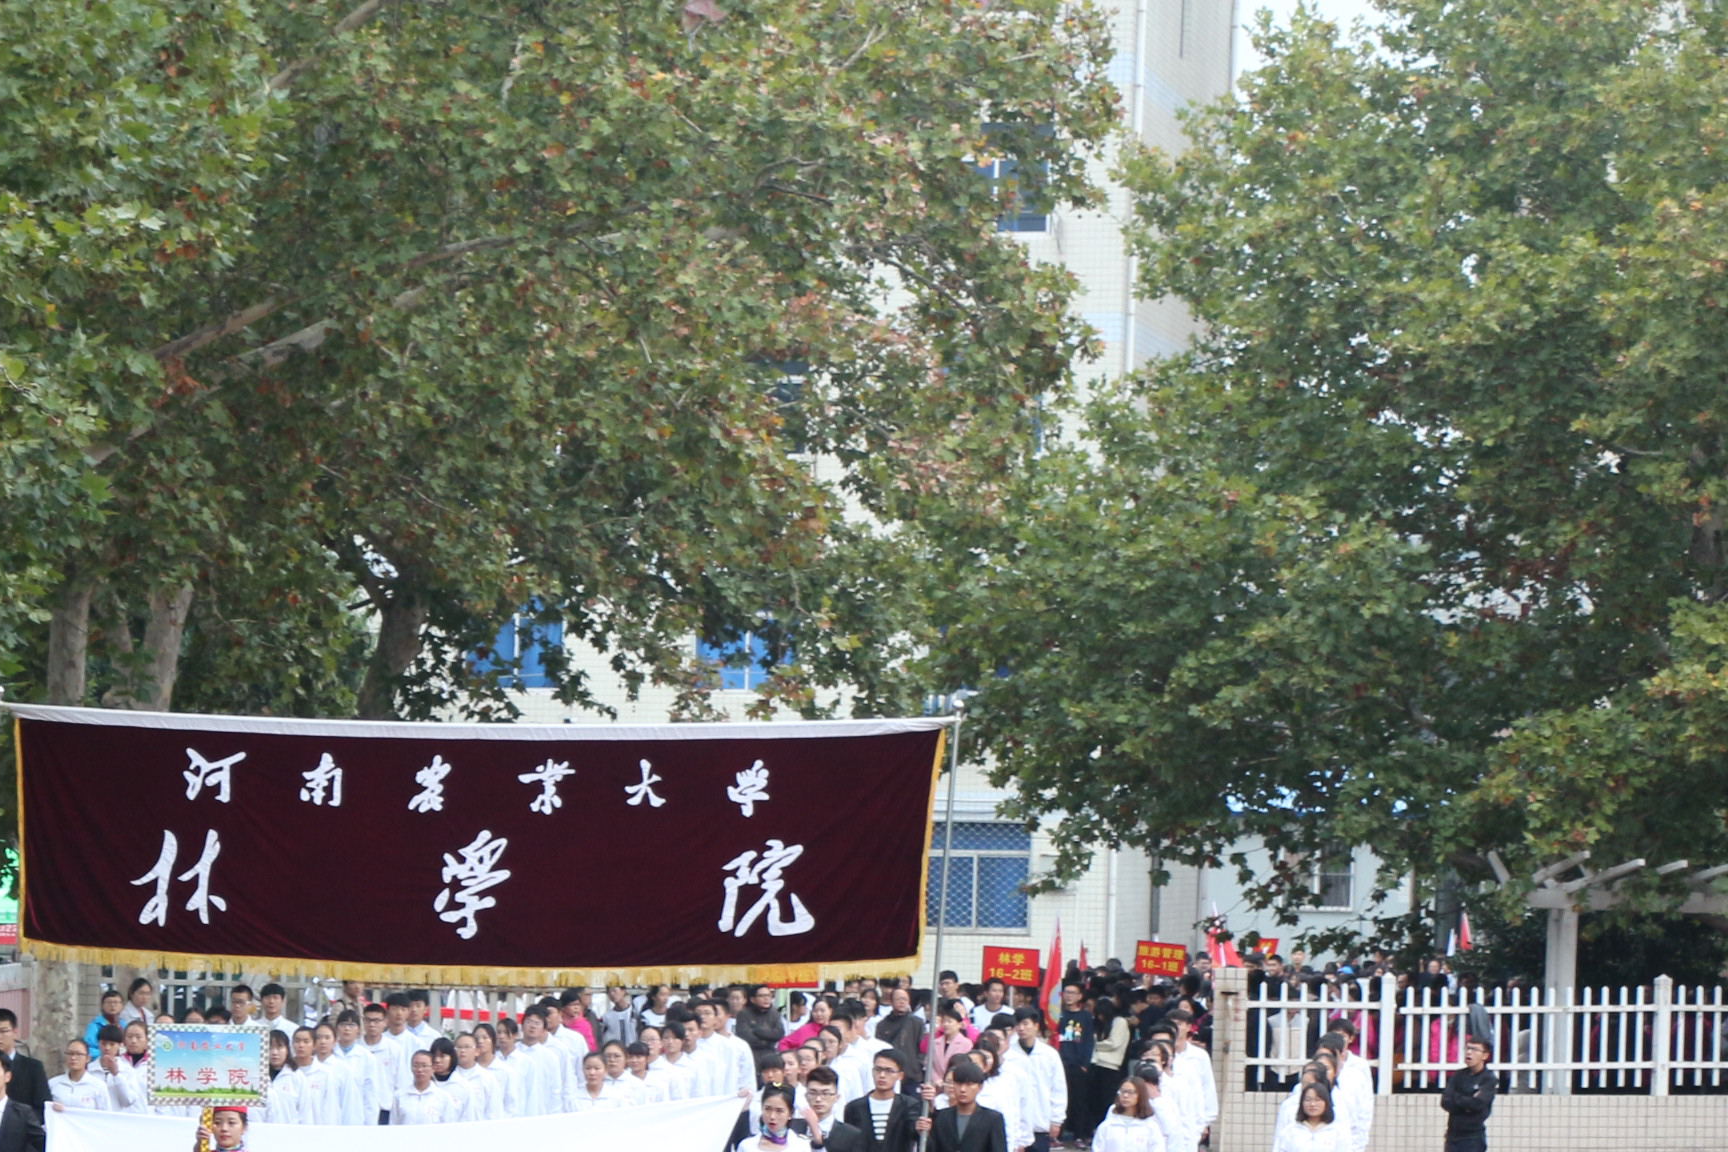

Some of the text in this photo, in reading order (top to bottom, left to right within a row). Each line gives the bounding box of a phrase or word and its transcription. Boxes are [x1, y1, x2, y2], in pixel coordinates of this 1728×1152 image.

[998, 951, 1025, 966] 林学
[164, 1067, 250, 1086] 林学院
